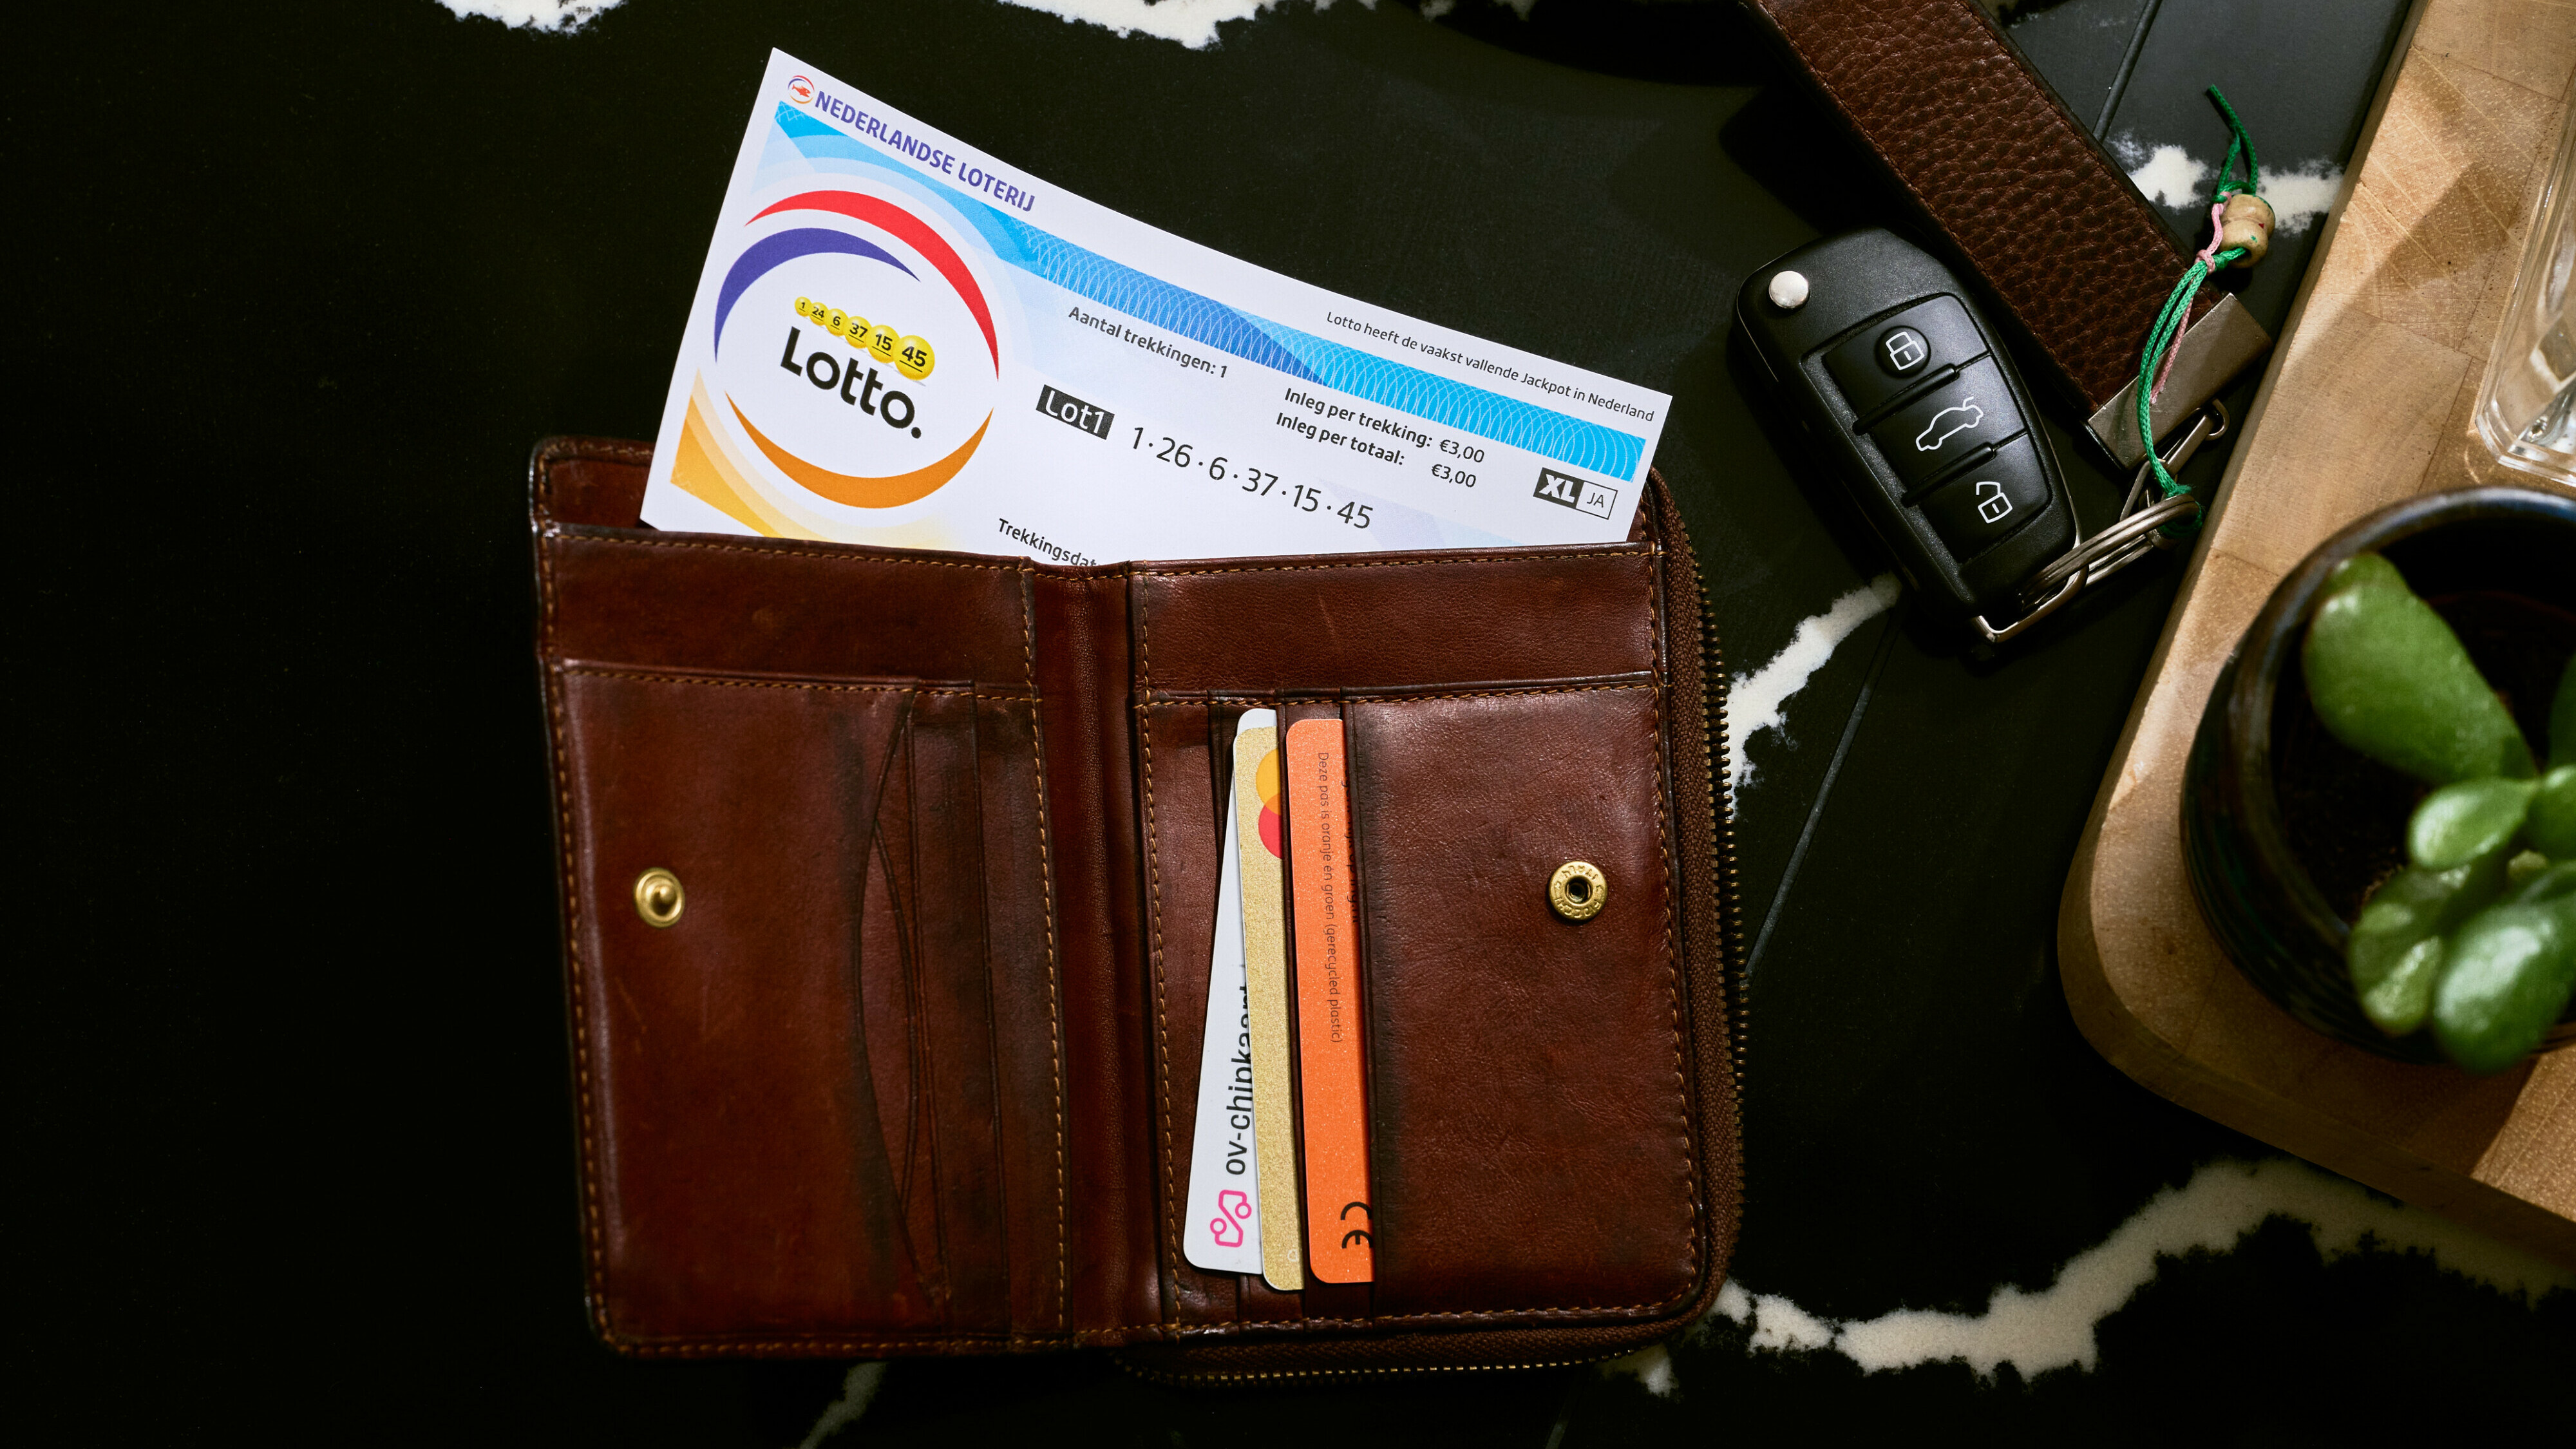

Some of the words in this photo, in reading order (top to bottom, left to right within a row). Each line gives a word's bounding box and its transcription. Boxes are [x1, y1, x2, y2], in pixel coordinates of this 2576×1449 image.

[815, 90, 956, 175] NEDERLANDSE
[958, 162, 1036, 213] LOTERIJ
[812, 306, 824, 319] 24
[833, 316, 841, 327] 6
[849, 323, 868, 338] 37
[875, 333, 893, 352] 15
[902, 345, 927, 367] 45
[1068, 306, 1122, 338] Aantal
[1124, 328, 1217, 375] trekkingen:
[1220, 365, 1228, 379] 1
[780, 326, 922, 439] Lotto.
[1327, 312, 1361, 331] Lotto
[1363, 323, 1400, 345] heeft
[1401, 336, 1417, 350] de
[1421, 343, 1463, 364] vaakst
[1466, 356, 1519, 381] vallende
[1520, 373, 1571, 397] Jackpot
[1573, 388, 1586, 401] in
[1587, 392, 1655, 422] Nederland
[1045, 390, 1104, 434] Lot1
[1284, 388, 1325, 415] Inleg
[1327, 404, 1356, 422] per
[1359, 412, 1433, 448] trekking:
[1439, 439, 1485, 463] €3,00
[1276, 412, 1317, 439] Inleg
[1318, 430, 1347, 446] per
[1350, 437, 1405, 466] totaal:
[1431, 463, 1477, 488] €3,00
[1539, 473, 1575, 504] XL
[1586, 492, 1604, 508] JA
[1318, 752, 1329, 781] Deze
[1317, 785, 1330, 806] pas
[1321, 810, 1332, 819] is
[1320, 822, 1334, 862] oranje
[1323, 865, 1334, 880] én
[1561, 864, 1598, 880] ITALY
[1321, 884, 1334, 920] groen
[1323, 923, 1340, 995] (gerecycled
[1327, 999, 1343, 1043] plastic)
